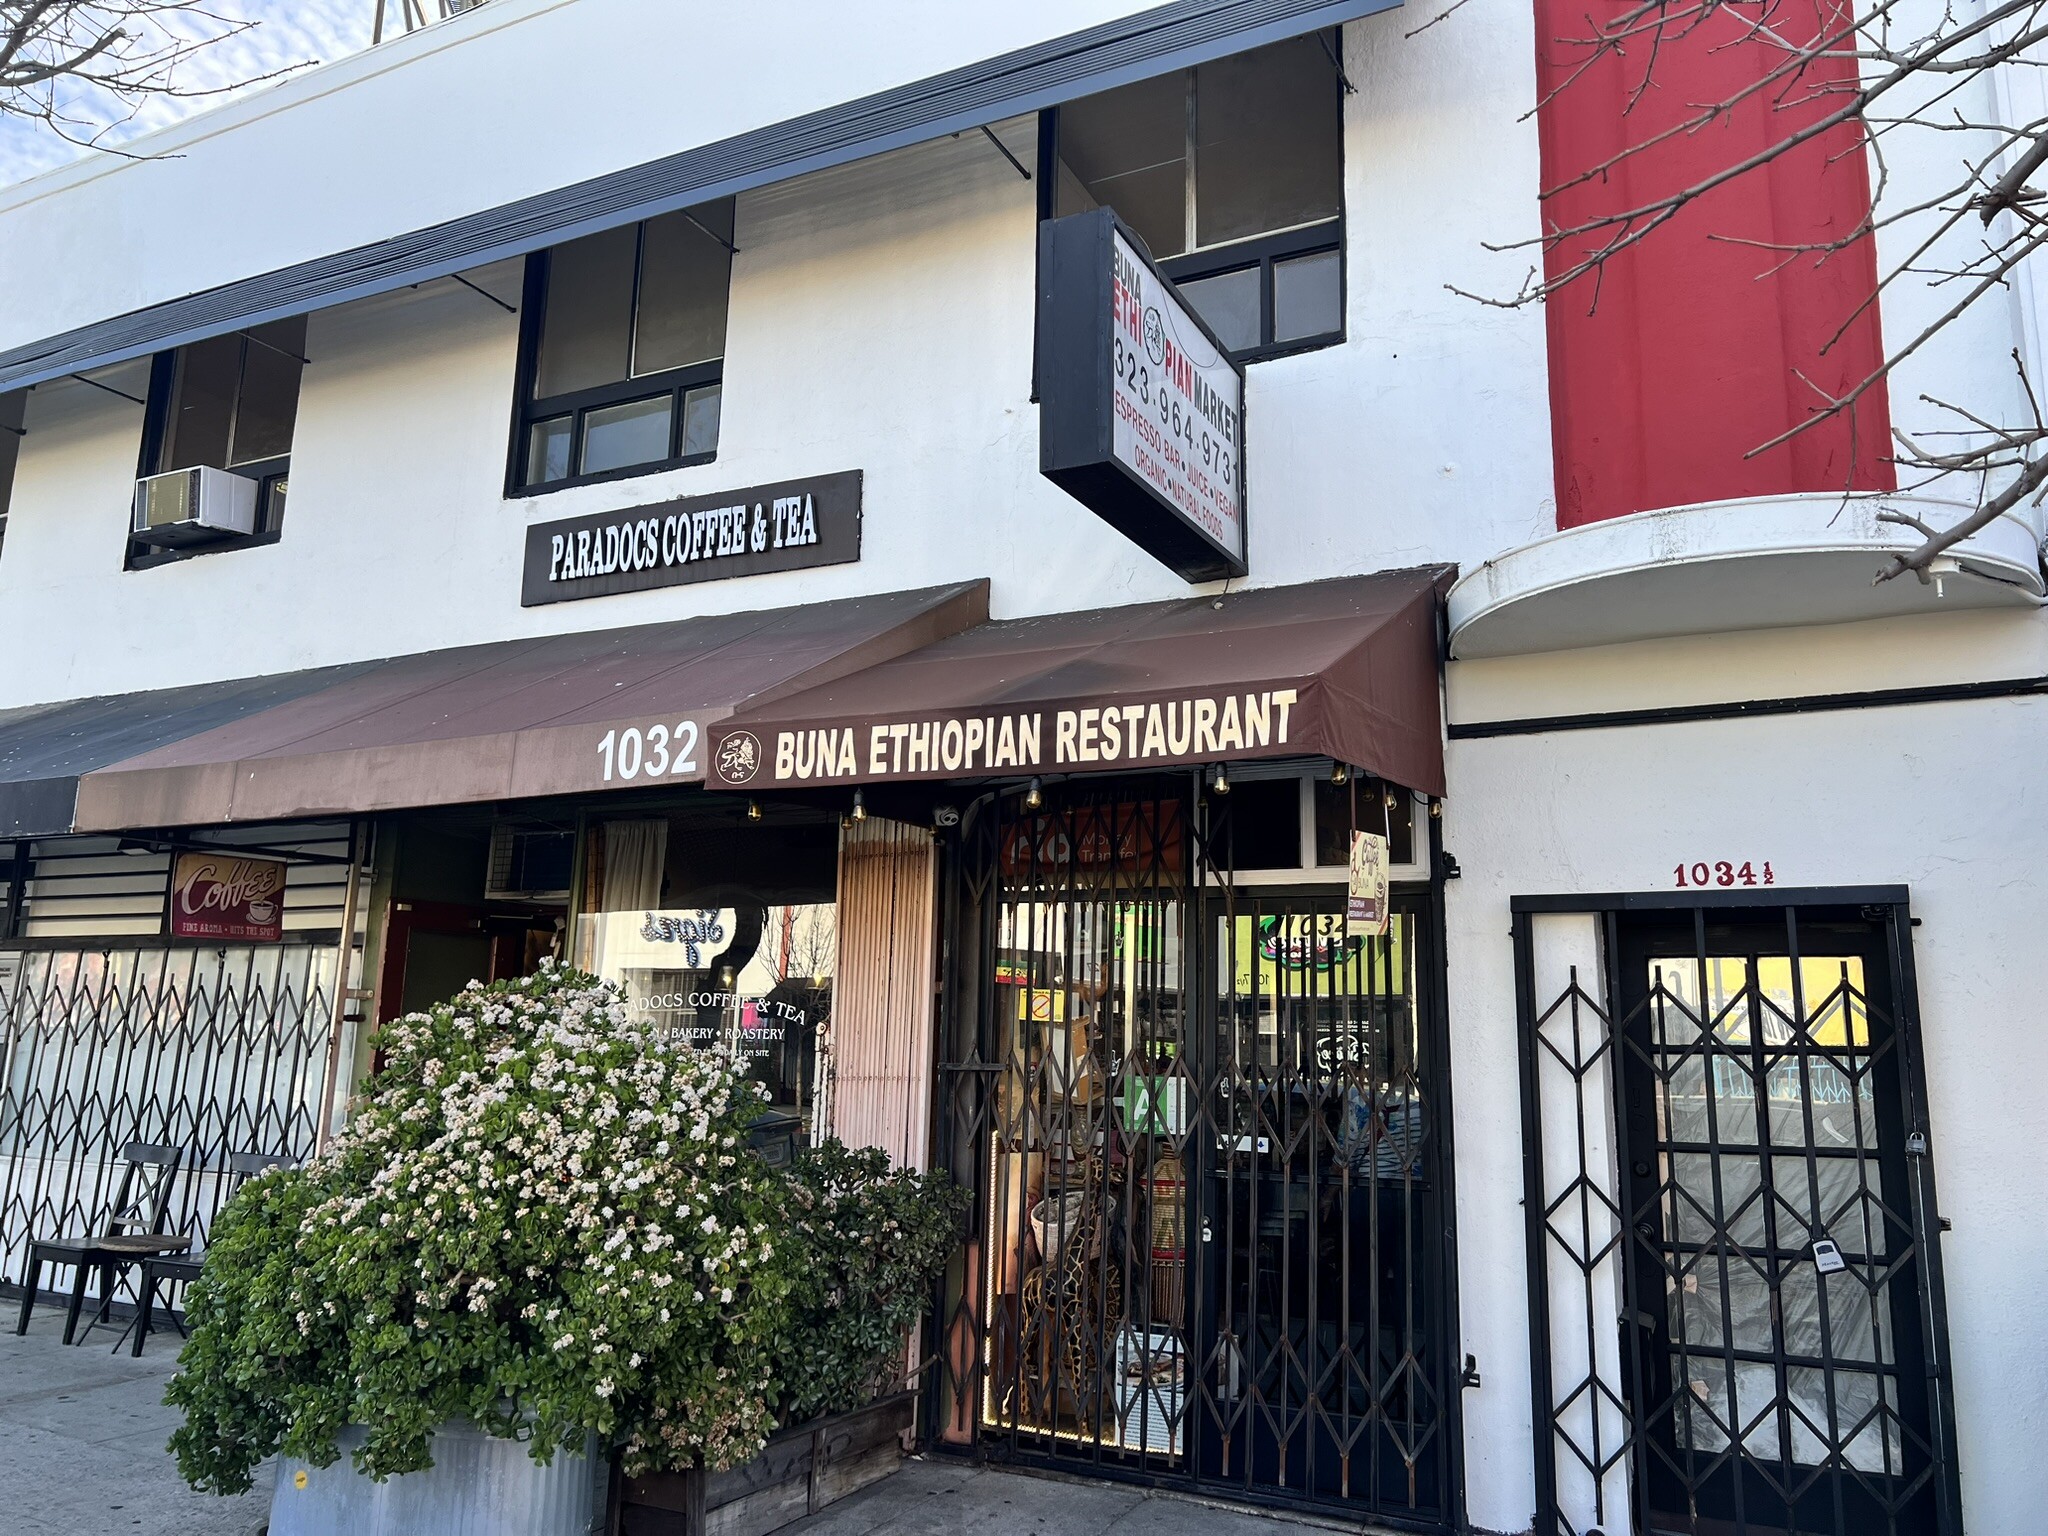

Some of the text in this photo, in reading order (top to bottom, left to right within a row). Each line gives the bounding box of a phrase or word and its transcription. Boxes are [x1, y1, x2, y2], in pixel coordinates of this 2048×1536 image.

[1114, 247, 1142, 306] BUNA
[1194, 370, 1238, 448] MARKET
[1115, 389, 1238, 525] ESPRESSO BAR JUICE VEGAN
[1134, 444, 1223, 541] ORGANIC NATURAL FOODS
[549, 492, 818, 582] PARADOCS COFFEE & TEA
[597, 719, 699, 782] 1032
[774, 688, 1298, 780] BUNA ETHIOPIAN RESTAURANT
[182, 861, 277, 915] Coffee
[183, 922, 275, 937] FINE AROMA HITS THE SPOT
[626, 992, 806, 1026] ADOCS COFFEE & TEA
[671, 1027, 714, 1039] BAKERY
[725, 1028, 785, 1040] ROASTERY
[755, 1049, 770, 1057] SITE
